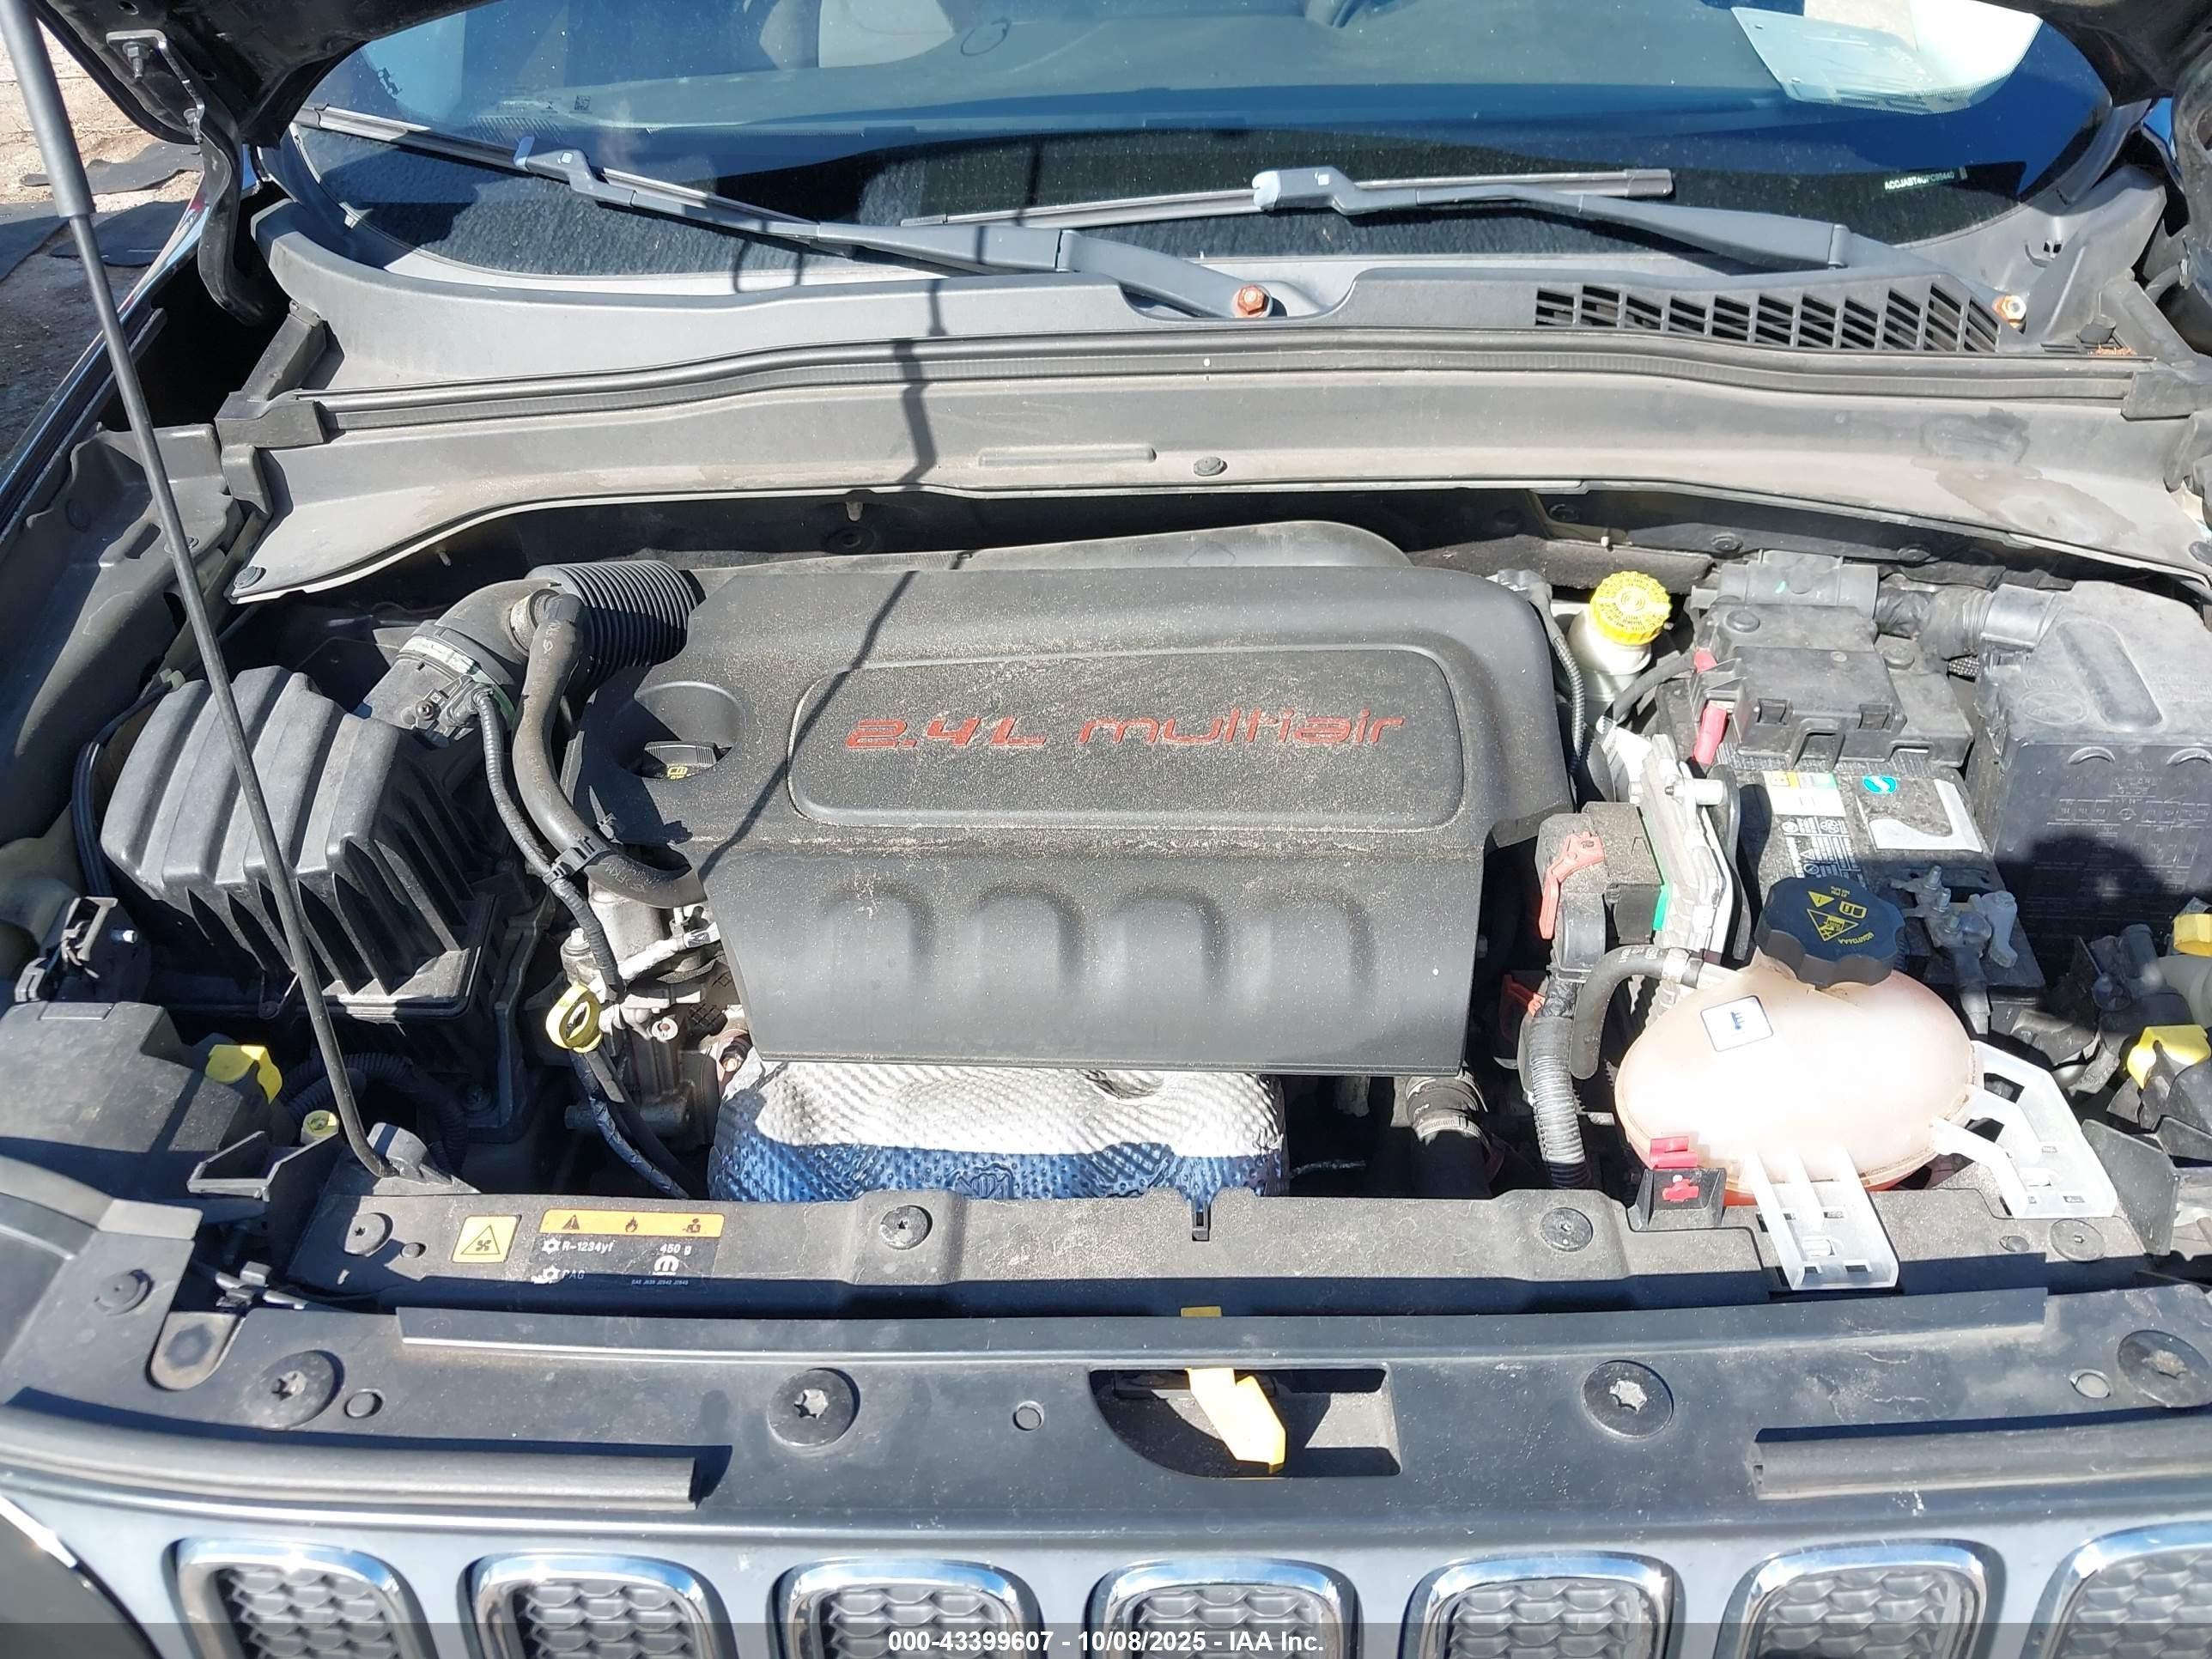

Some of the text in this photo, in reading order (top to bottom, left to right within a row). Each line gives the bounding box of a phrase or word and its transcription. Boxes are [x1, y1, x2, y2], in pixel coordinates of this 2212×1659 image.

[846, 707, 1404, 749] 2.4L multiair
[562, 1239, 615, 1255] R-1234yf
[659, 1243, 681, 1254] 450
